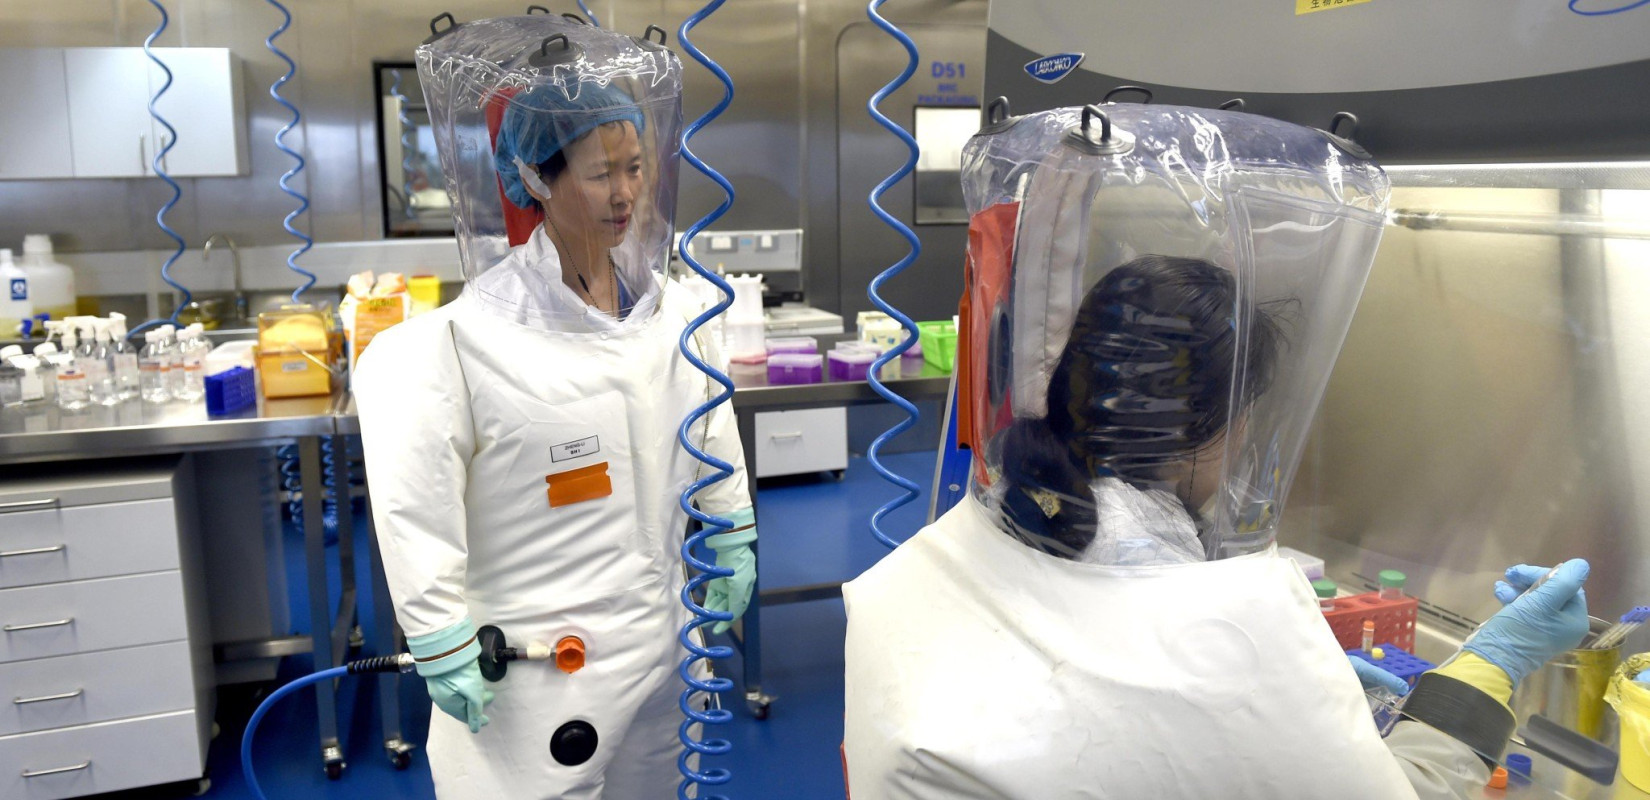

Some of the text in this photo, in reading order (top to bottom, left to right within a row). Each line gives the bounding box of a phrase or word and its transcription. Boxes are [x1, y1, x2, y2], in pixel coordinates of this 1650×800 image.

[1311, 0, 1354, 8] 生物危
[931, 61, 966, 78] D51
